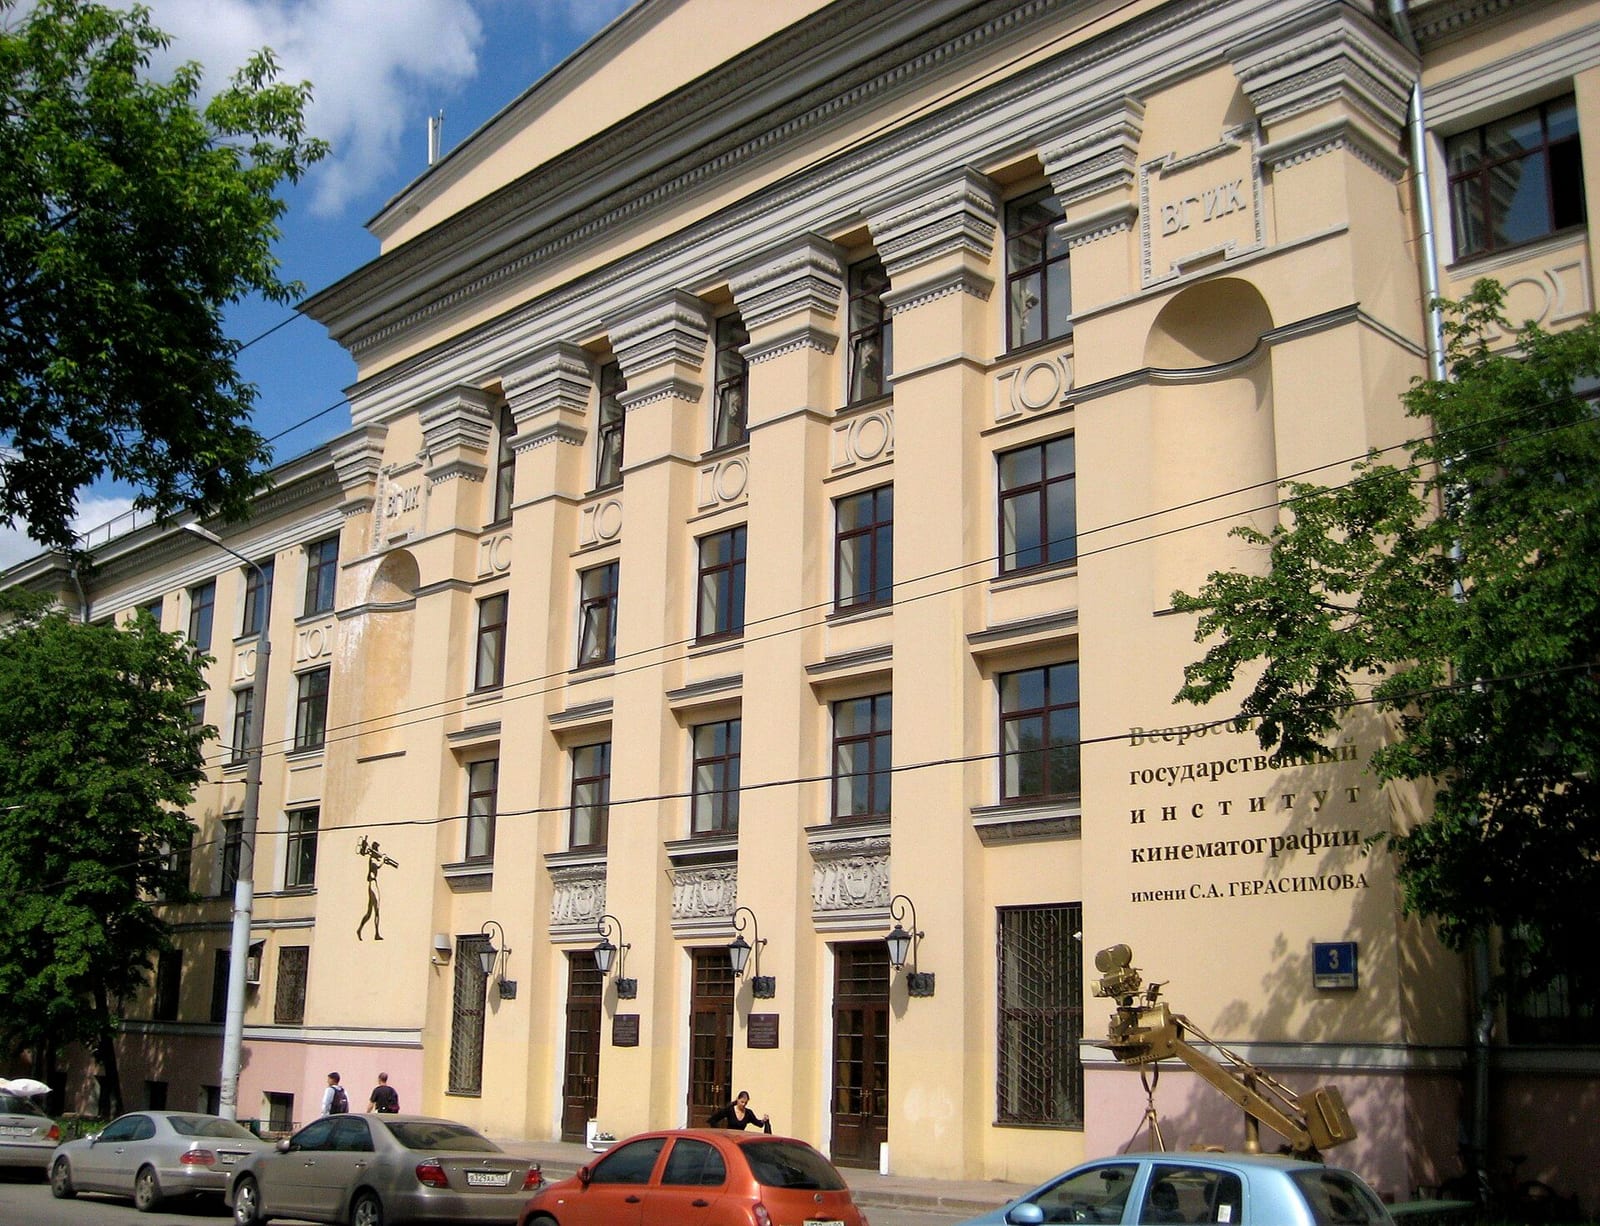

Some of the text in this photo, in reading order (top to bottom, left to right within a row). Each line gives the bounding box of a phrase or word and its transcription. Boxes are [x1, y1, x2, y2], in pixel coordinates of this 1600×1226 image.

[1161, 179, 1247, 237] ВГИК
[1131, 827, 1361, 863] кинематографии
[1131, 873, 1370, 903] имени С.А. ГЕРАСИМОВА
[1328, 949, 1340, 970] 3
